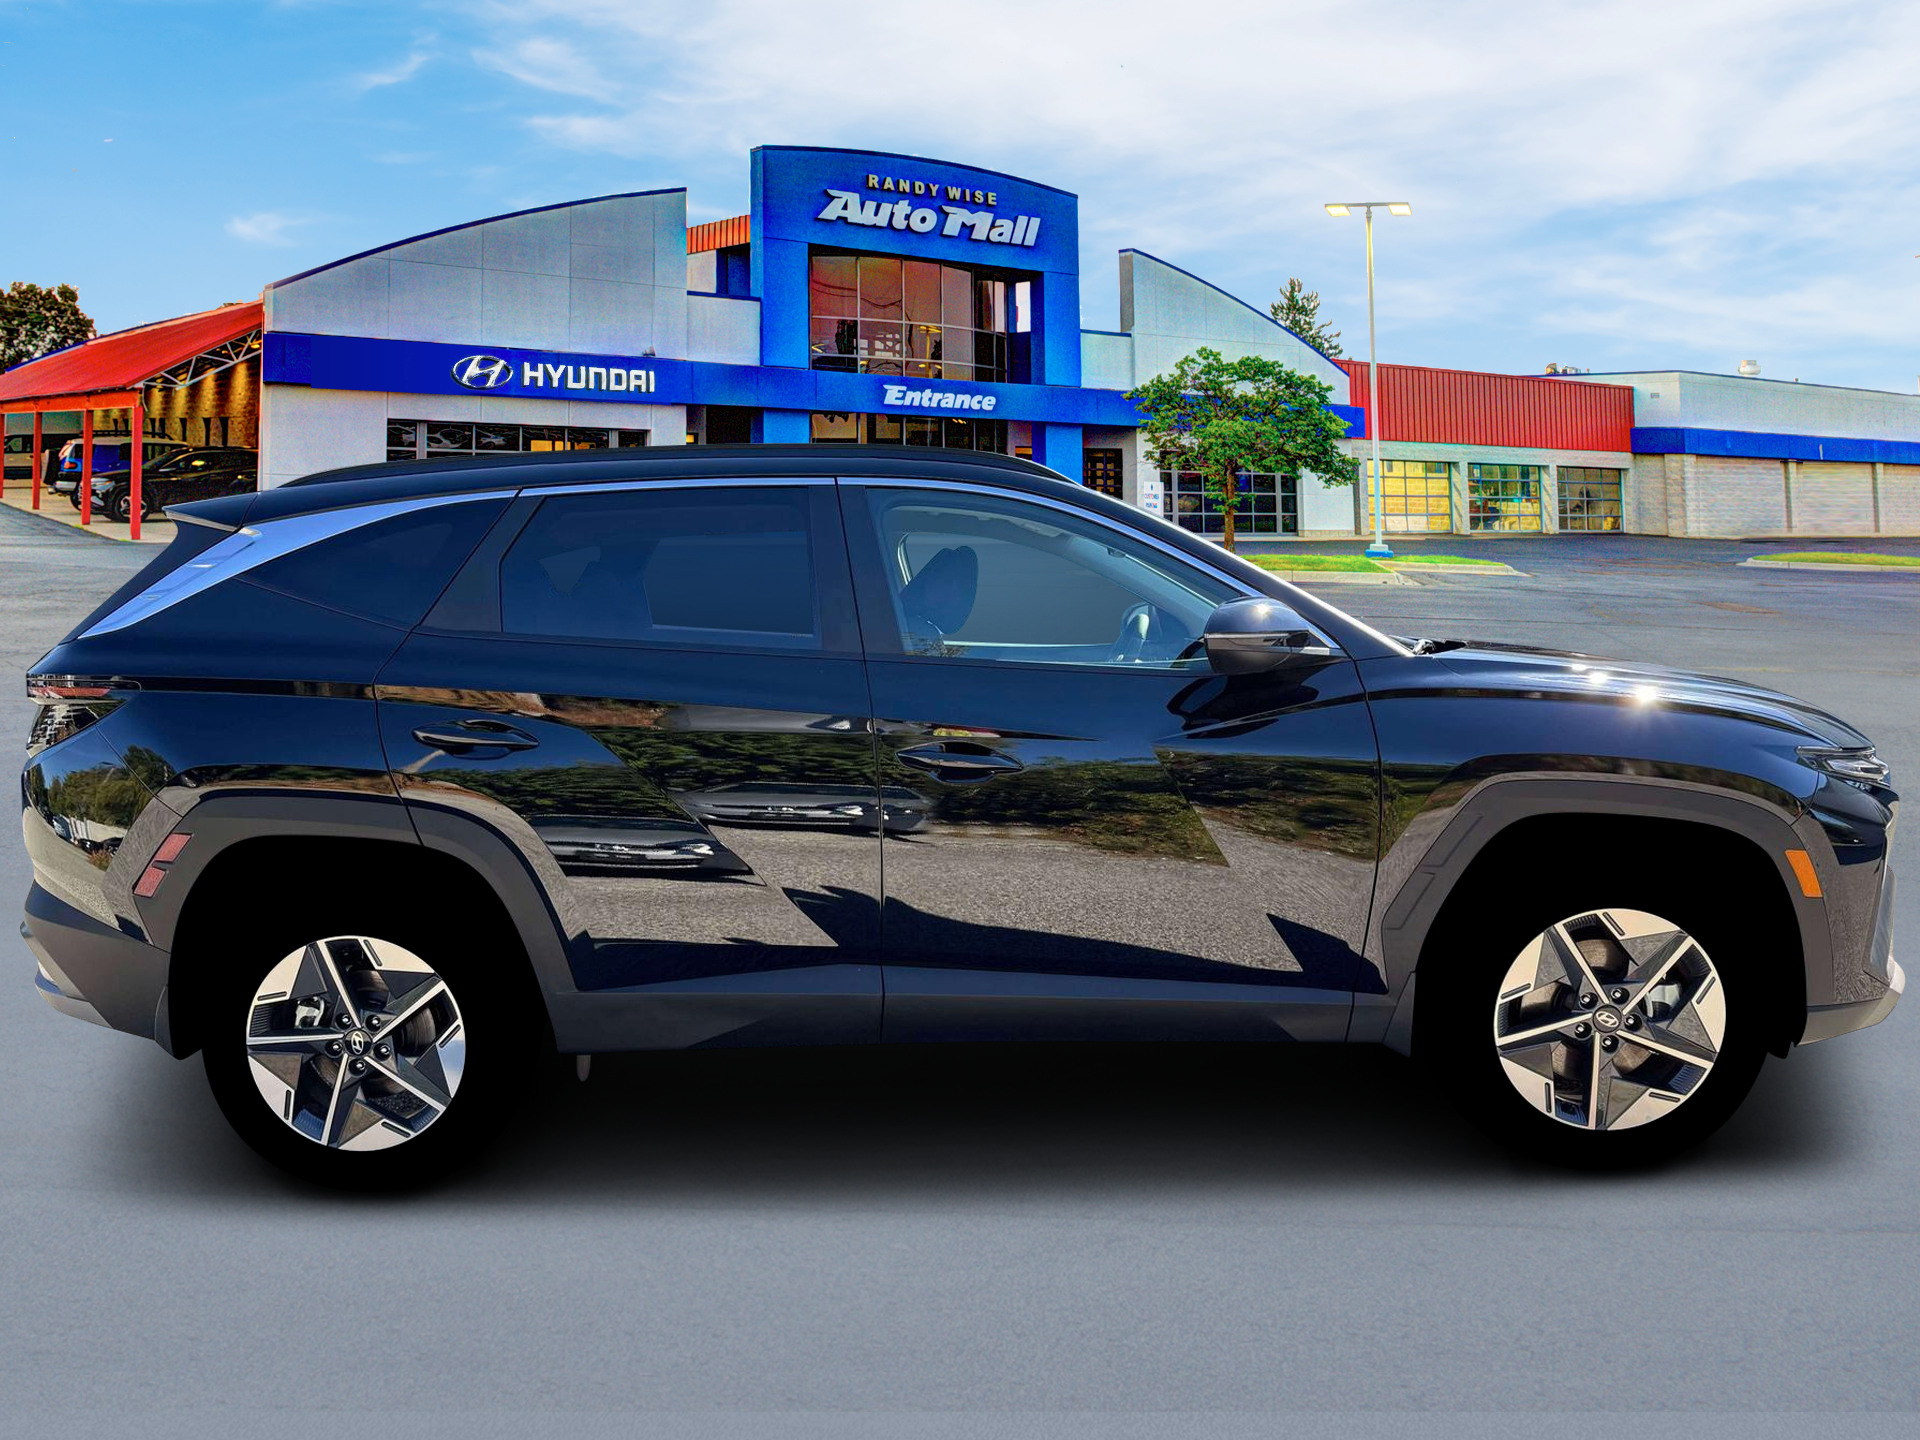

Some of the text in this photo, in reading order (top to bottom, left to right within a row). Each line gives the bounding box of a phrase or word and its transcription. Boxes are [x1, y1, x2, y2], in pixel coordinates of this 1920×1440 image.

[867, 174, 997, 205] RANDY WISE
[817, 189, 1041, 246] Auto Mall
[521, 361, 655, 393] HYUNDAI
[883, 384, 996, 411] Entrance
